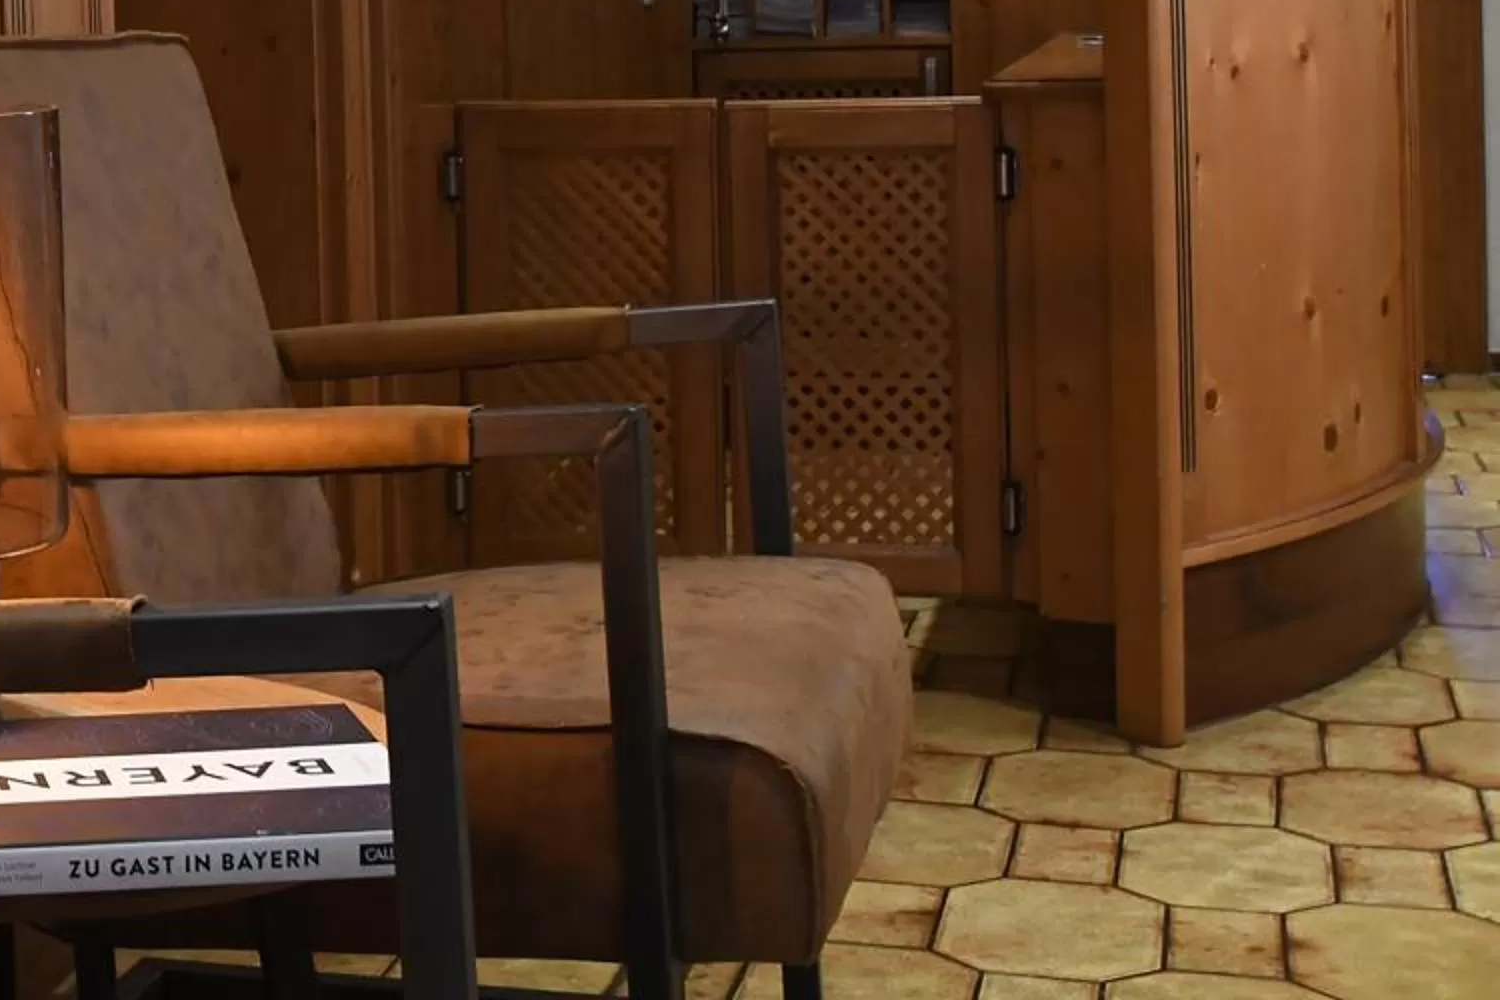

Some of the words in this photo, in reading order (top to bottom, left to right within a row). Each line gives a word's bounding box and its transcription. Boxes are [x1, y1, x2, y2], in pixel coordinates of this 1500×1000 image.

[69, 858, 99, 878] ZU
[111, 855, 175, 876] GAST
[185, 853, 211, 872] IN
[221, 847, 320, 871] BAYERN
